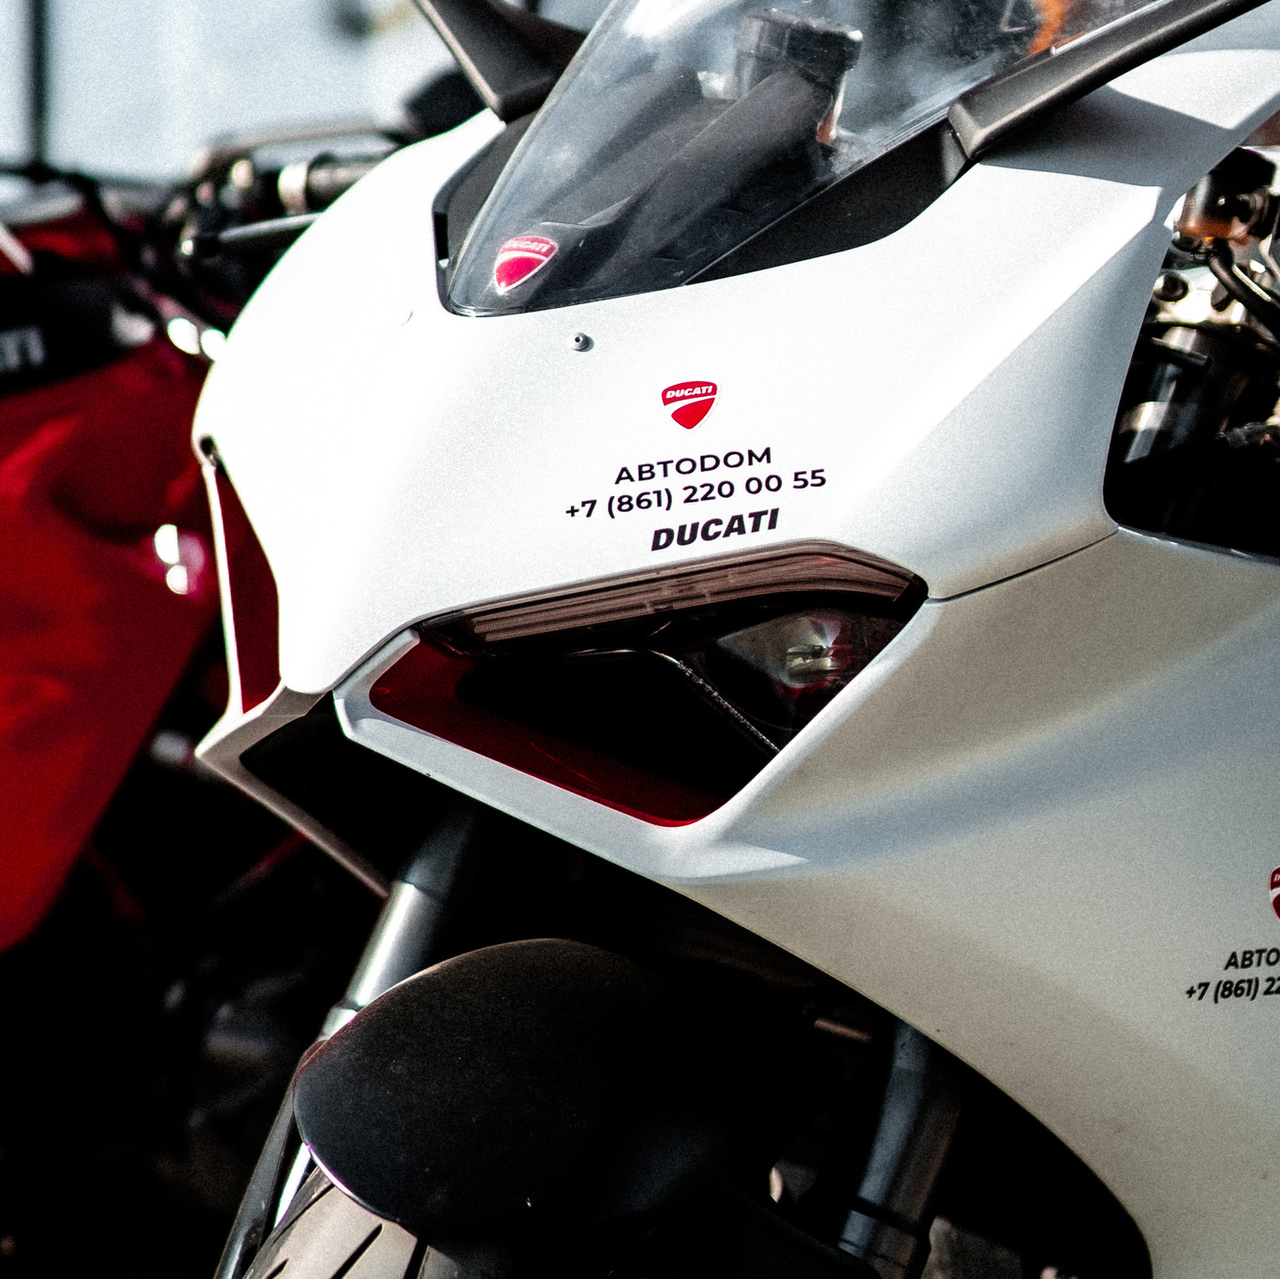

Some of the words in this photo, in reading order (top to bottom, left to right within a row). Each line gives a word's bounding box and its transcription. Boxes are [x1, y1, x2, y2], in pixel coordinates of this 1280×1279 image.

[665, 385, 713, 399] DUCATI
[565, 499, 598, 518] +7
[607, 488, 673, 519] (861)
[683, 480, 735, 504] 220
[745, 474, 783, 495] 00
[793, 469, 827, 489] 55
[651, 507, 780, 552] DUCATI
[1186, 981, 1210, 1001] +7
[1214, 977, 1259, 1004] (861)
